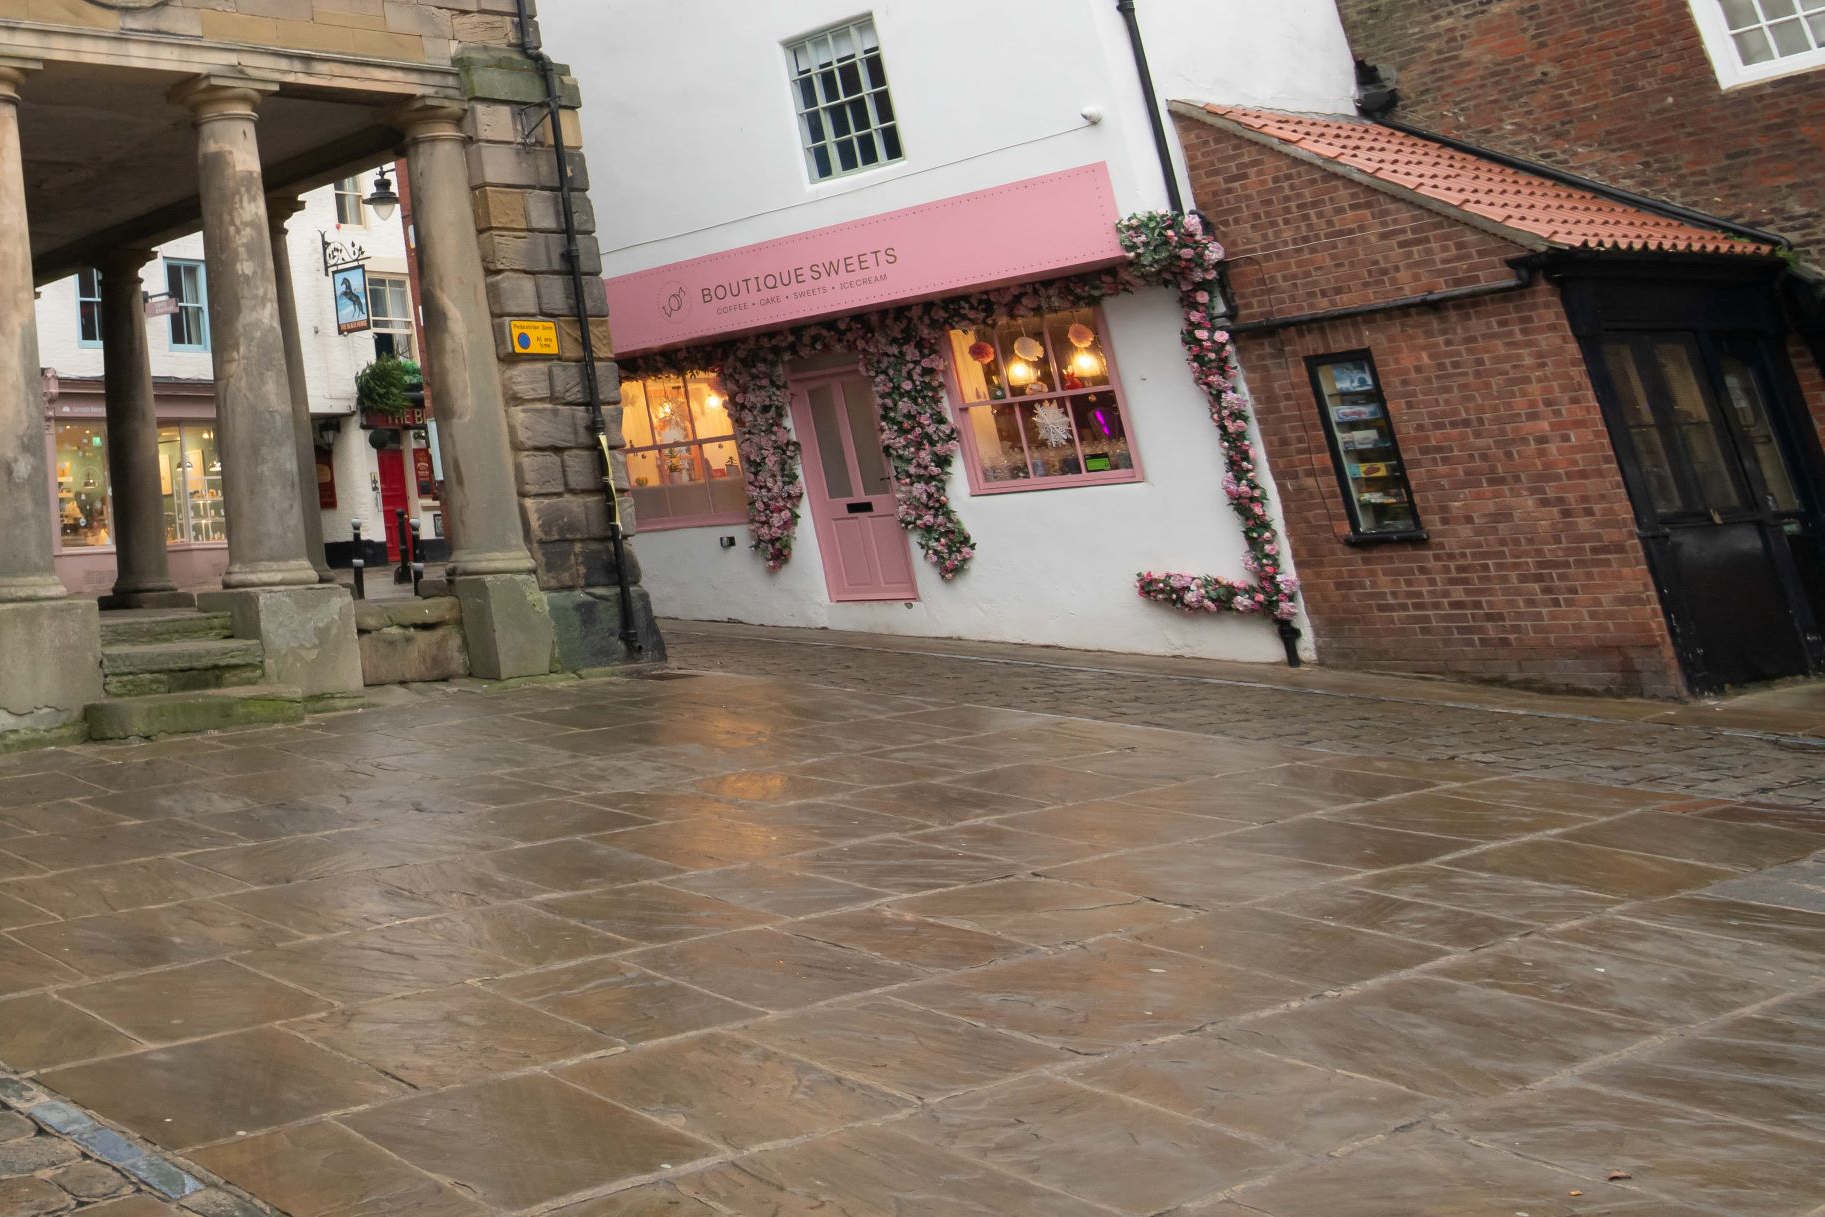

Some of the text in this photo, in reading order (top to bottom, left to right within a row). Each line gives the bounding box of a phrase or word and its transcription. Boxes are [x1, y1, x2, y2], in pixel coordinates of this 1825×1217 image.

[701, 247, 898, 303] BOUTIQUE SWEETS
[716, 273, 888, 315] COFFEE CAKE SWEETS ICECREAM
